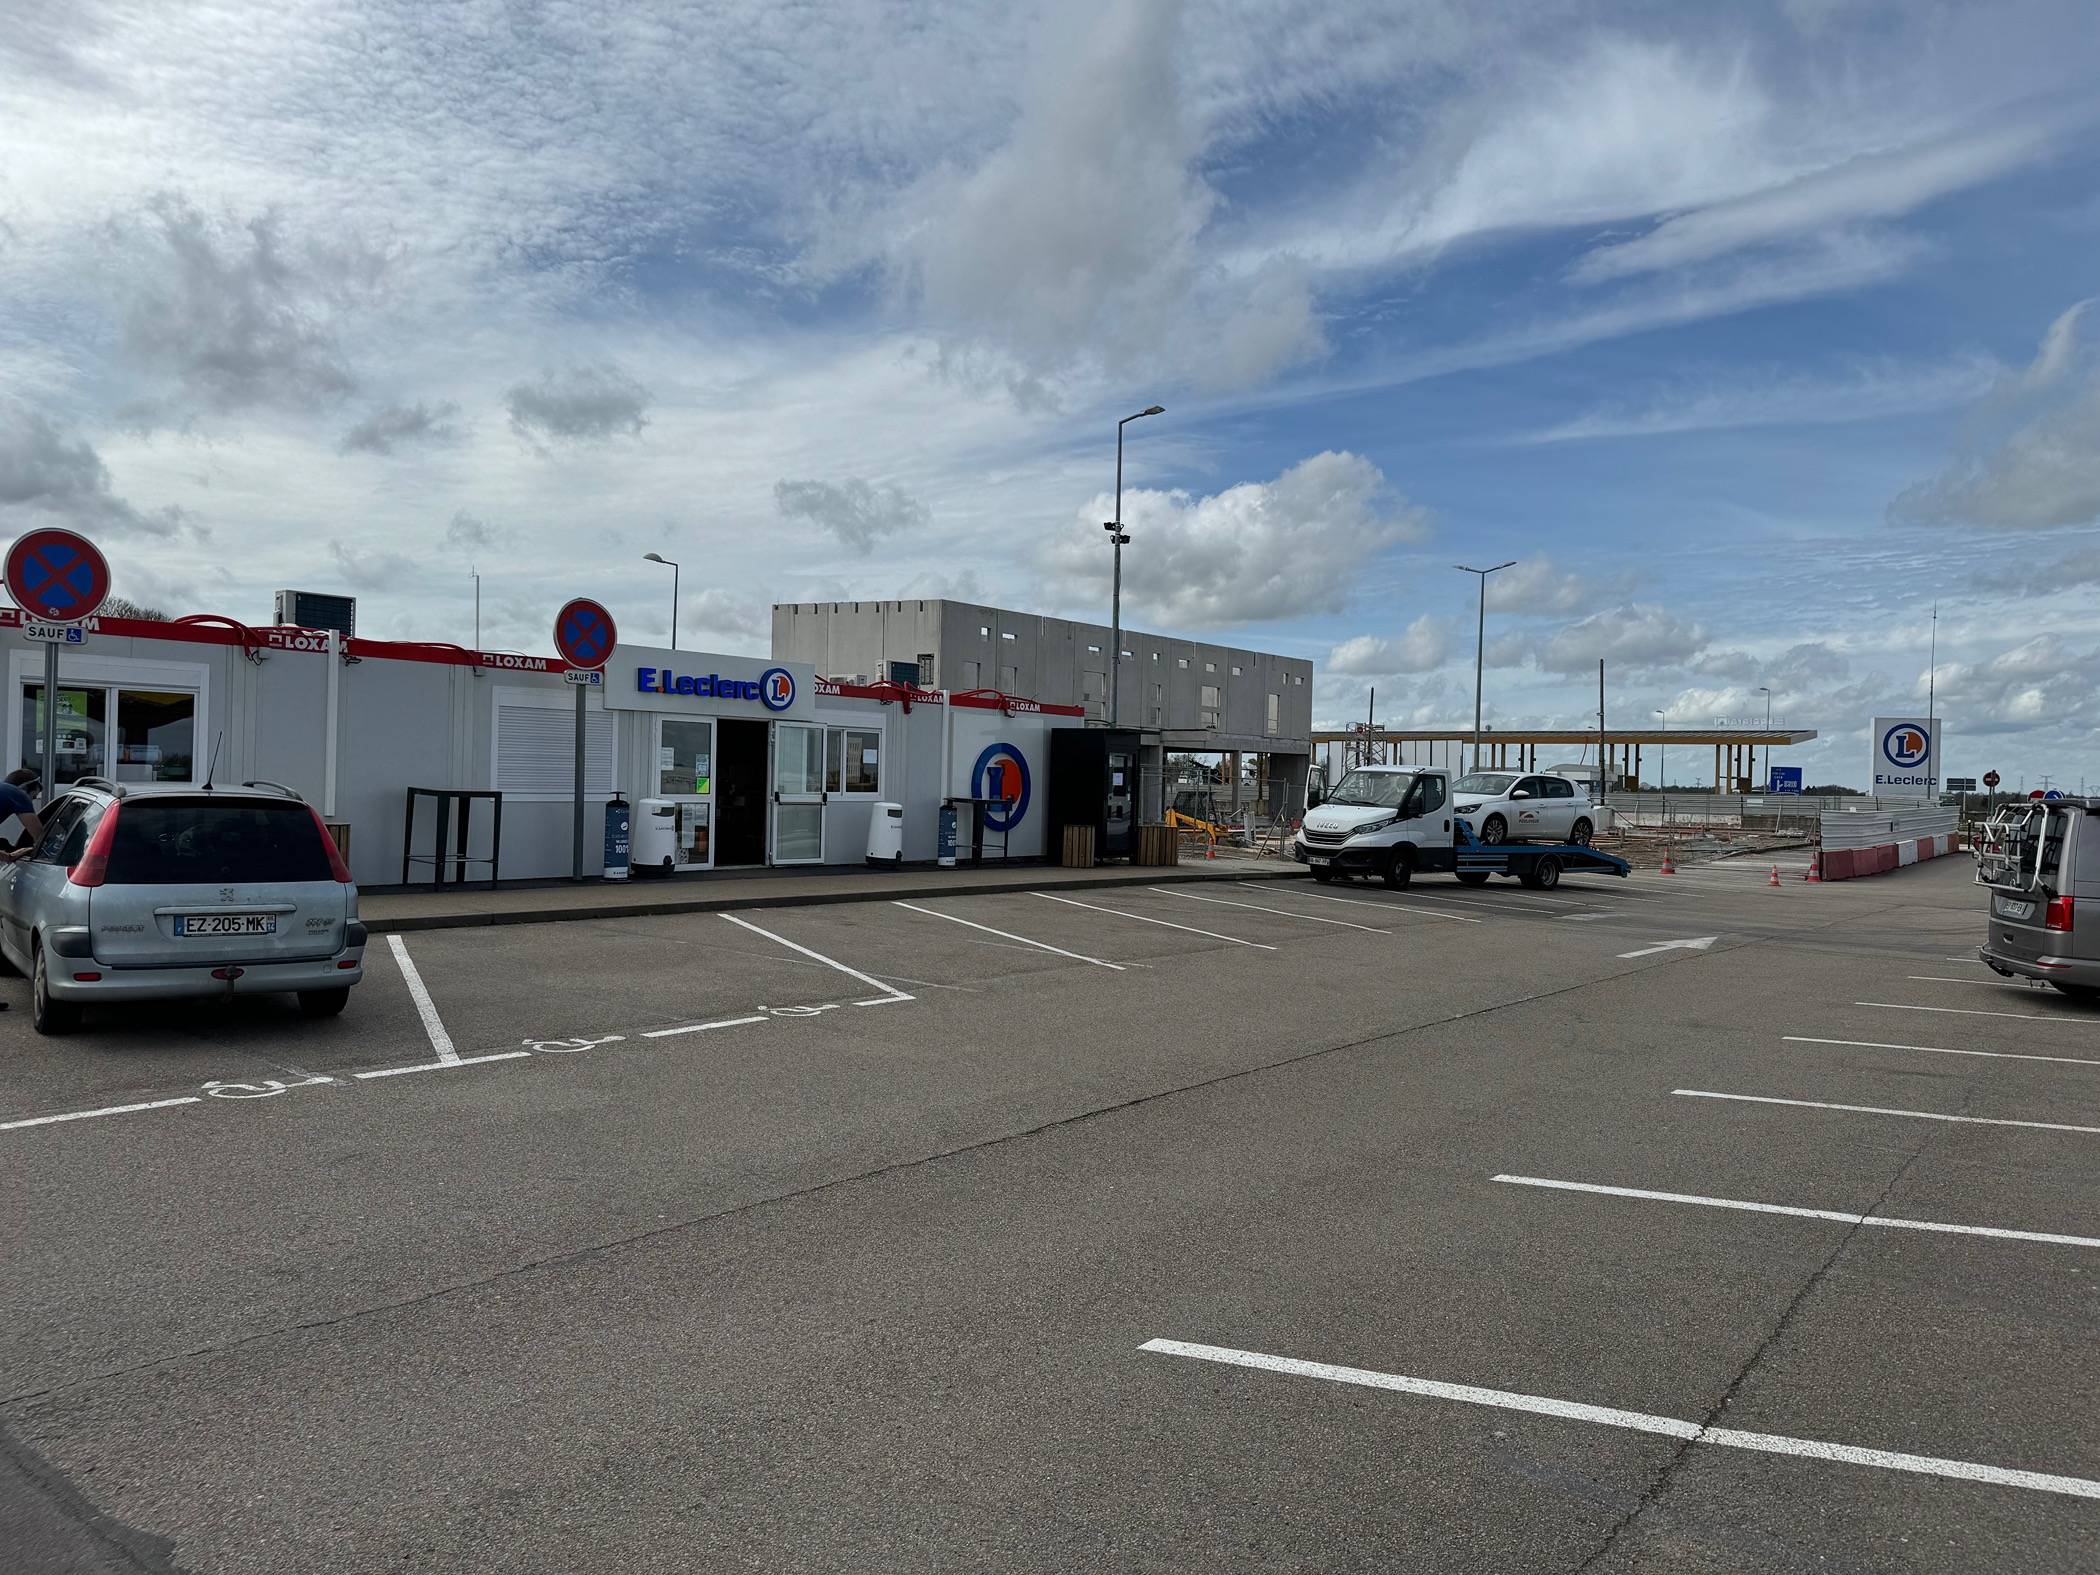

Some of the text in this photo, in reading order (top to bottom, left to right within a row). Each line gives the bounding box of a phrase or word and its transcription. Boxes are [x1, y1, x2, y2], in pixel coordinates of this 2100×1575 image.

[28, 626, 64, 639] SAUF
[495, 655, 547, 671] LOXAM
[567, 673, 590, 682] SAUF
[637, 667, 760, 700] E.Leclerc
[1016, 702, 1041, 713] LOXAM
[1875, 774, 1937, 786] E.Leclerc
